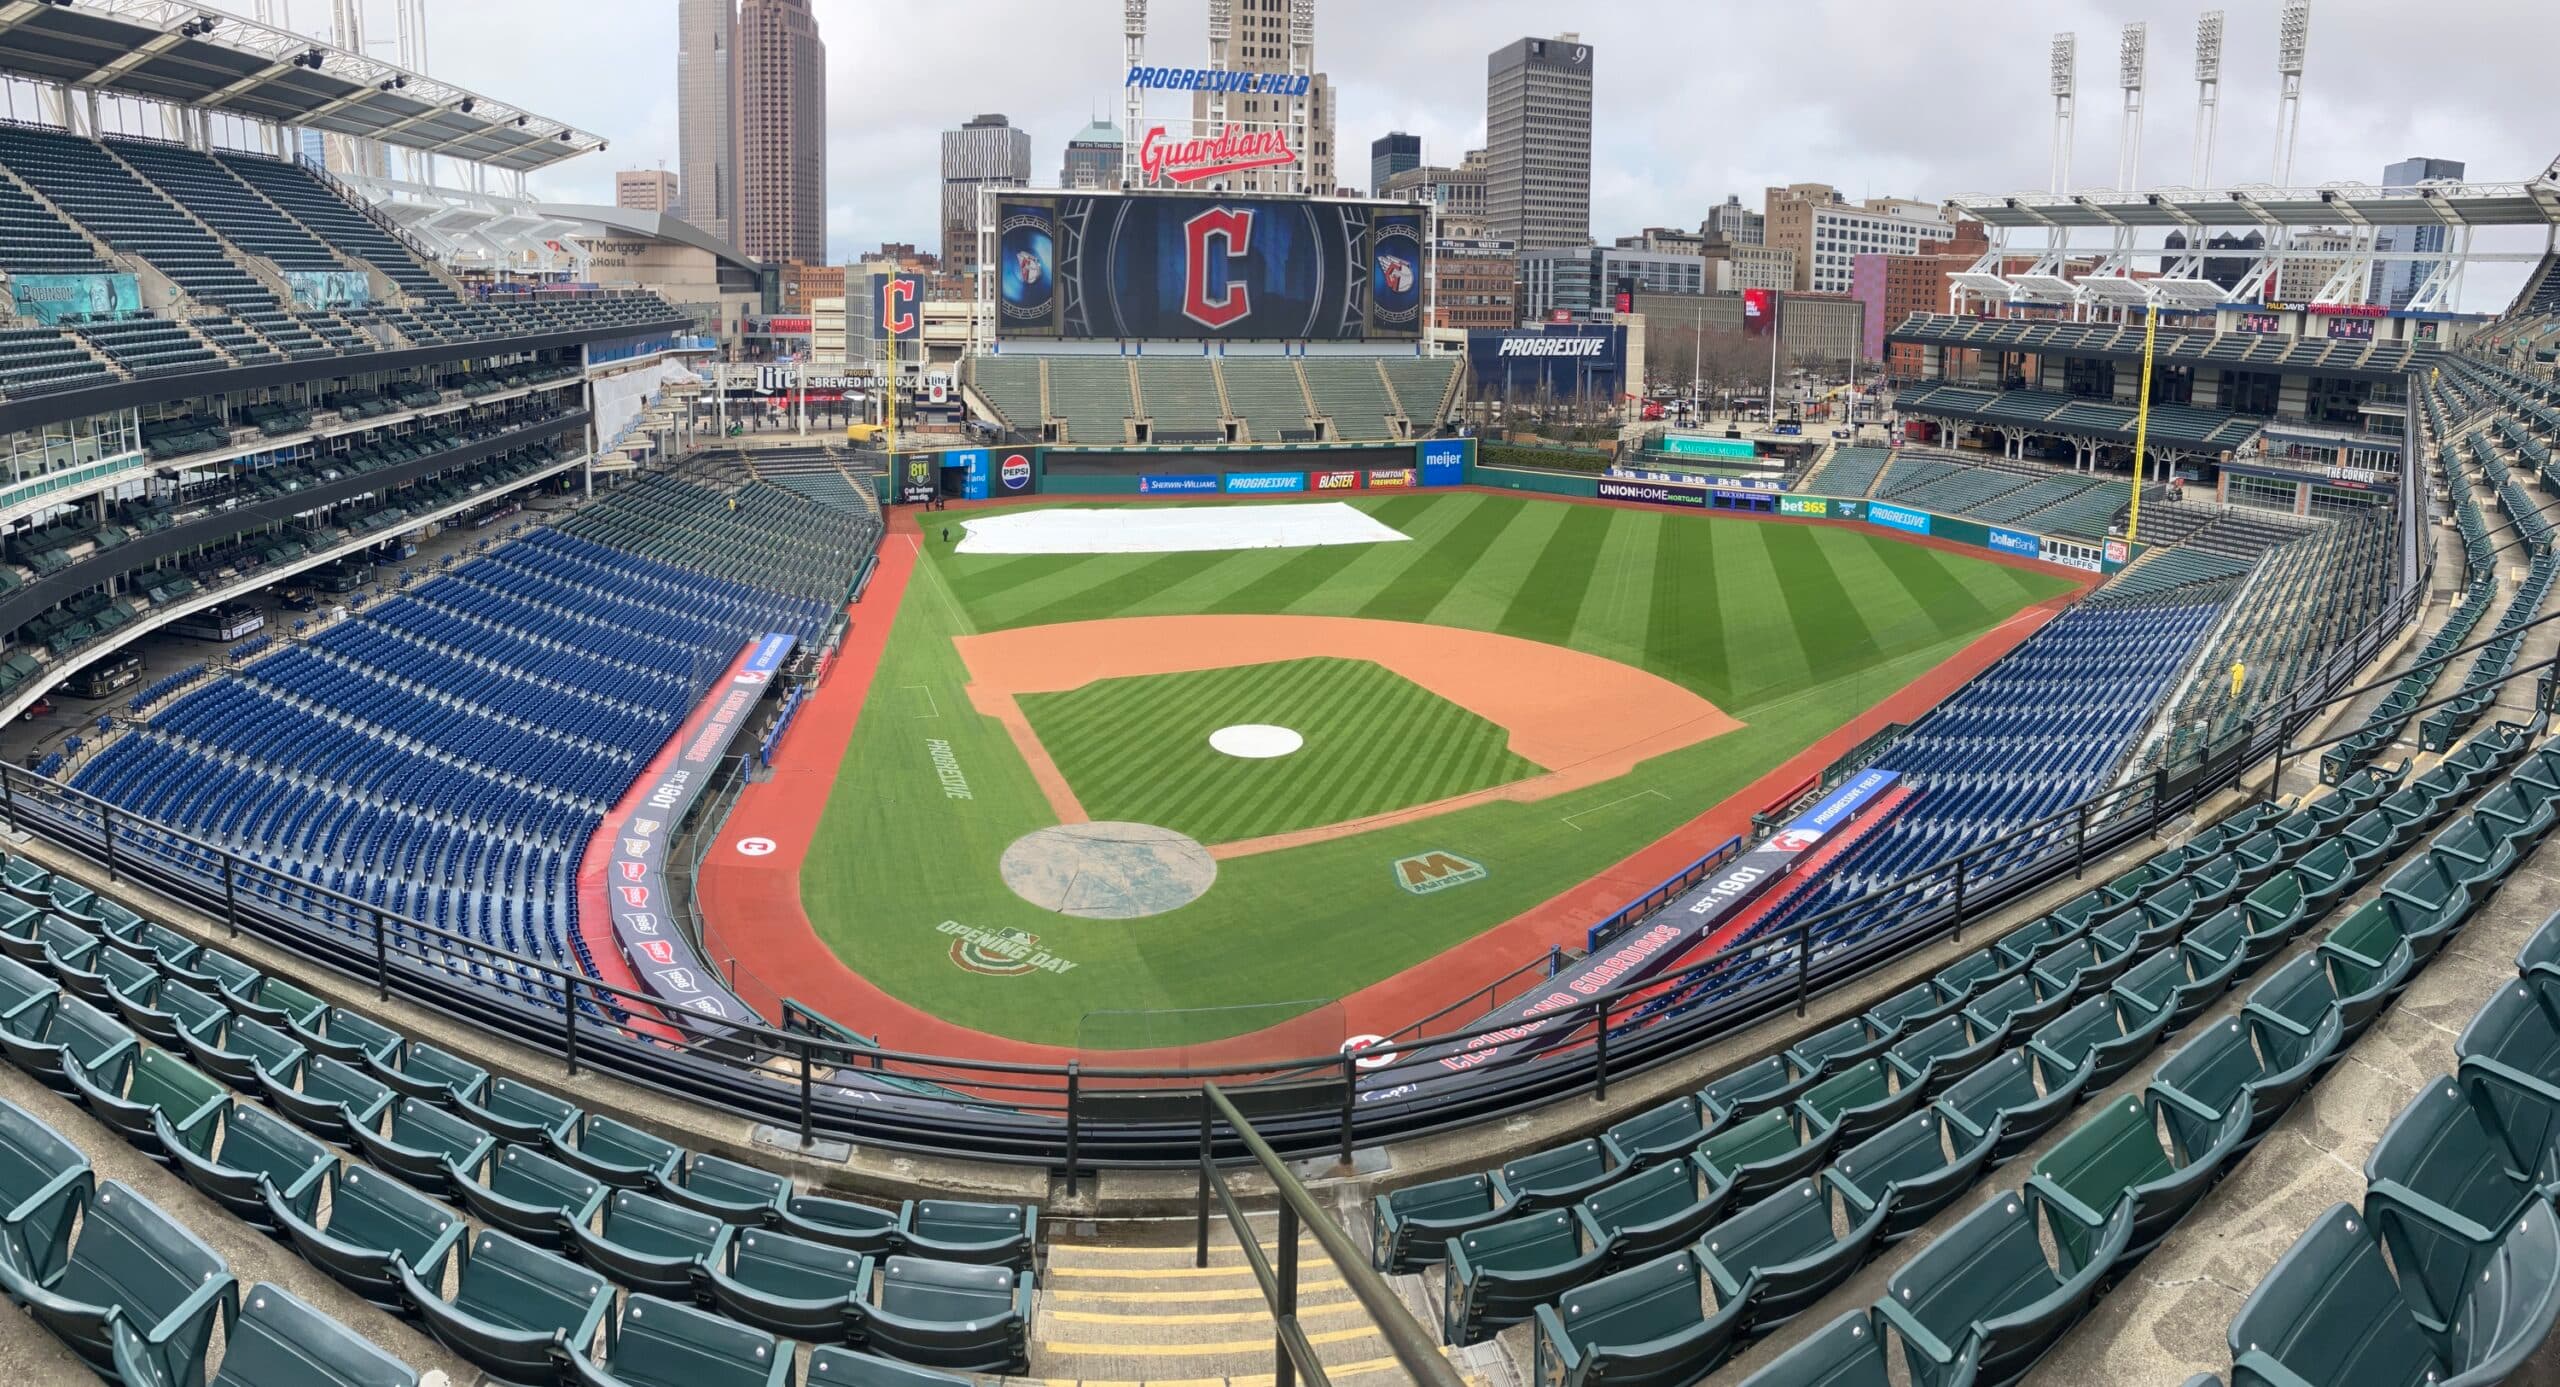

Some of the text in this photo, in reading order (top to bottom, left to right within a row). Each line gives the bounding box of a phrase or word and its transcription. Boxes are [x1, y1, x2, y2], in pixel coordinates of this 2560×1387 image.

[1125, 66, 1310, 96] PROGRESSIVE FIELD
[1140, 124, 1296, 185] Guardians
[596, 240, 646, 256] Mortgage
[21, 283, 74, 301] ROBINSON
[1498, 337, 1607, 356] PROGRESSIVE
[755, 365, 798, 394] Lite
[844, 369, 875, 377] PROUDLY
[815, 376, 862, 388] BREWED
[863, 376, 875, 388] IN
[1684, 445, 1716, 454] MEDICAL
[1426, 451, 1462, 467] meijer
[910, 463, 928, 477] 811
[1003, 468, 1029, 477] PEPSI
[1371, 470, 1405, 480] PHANTOM
[2326, 466, 2375, 484] THE CORNER
[1228, 477, 1298, 489] PROGRESSIVE
[1319, 475, 1354, 488] BLASTER
[1370, 478, 1404, 486] FIREWORKS
[1667, 494, 1703, 504] MORTGAGE
[1781, 500, 1826, 513] bet365
[1869, 506, 1926, 529] PROGRESSIVE
[2062, 557, 2094, 570] CLIFFS
[647, 782, 685, 809] 1901
[1813, 773, 1882, 825] PROGRESSIVE FIELD
[1711, 866, 1766, 896] 1901
[935, 920, 1080, 974] OPENING DAY
[1569, 925, 1681, 995] GUARDIANS
